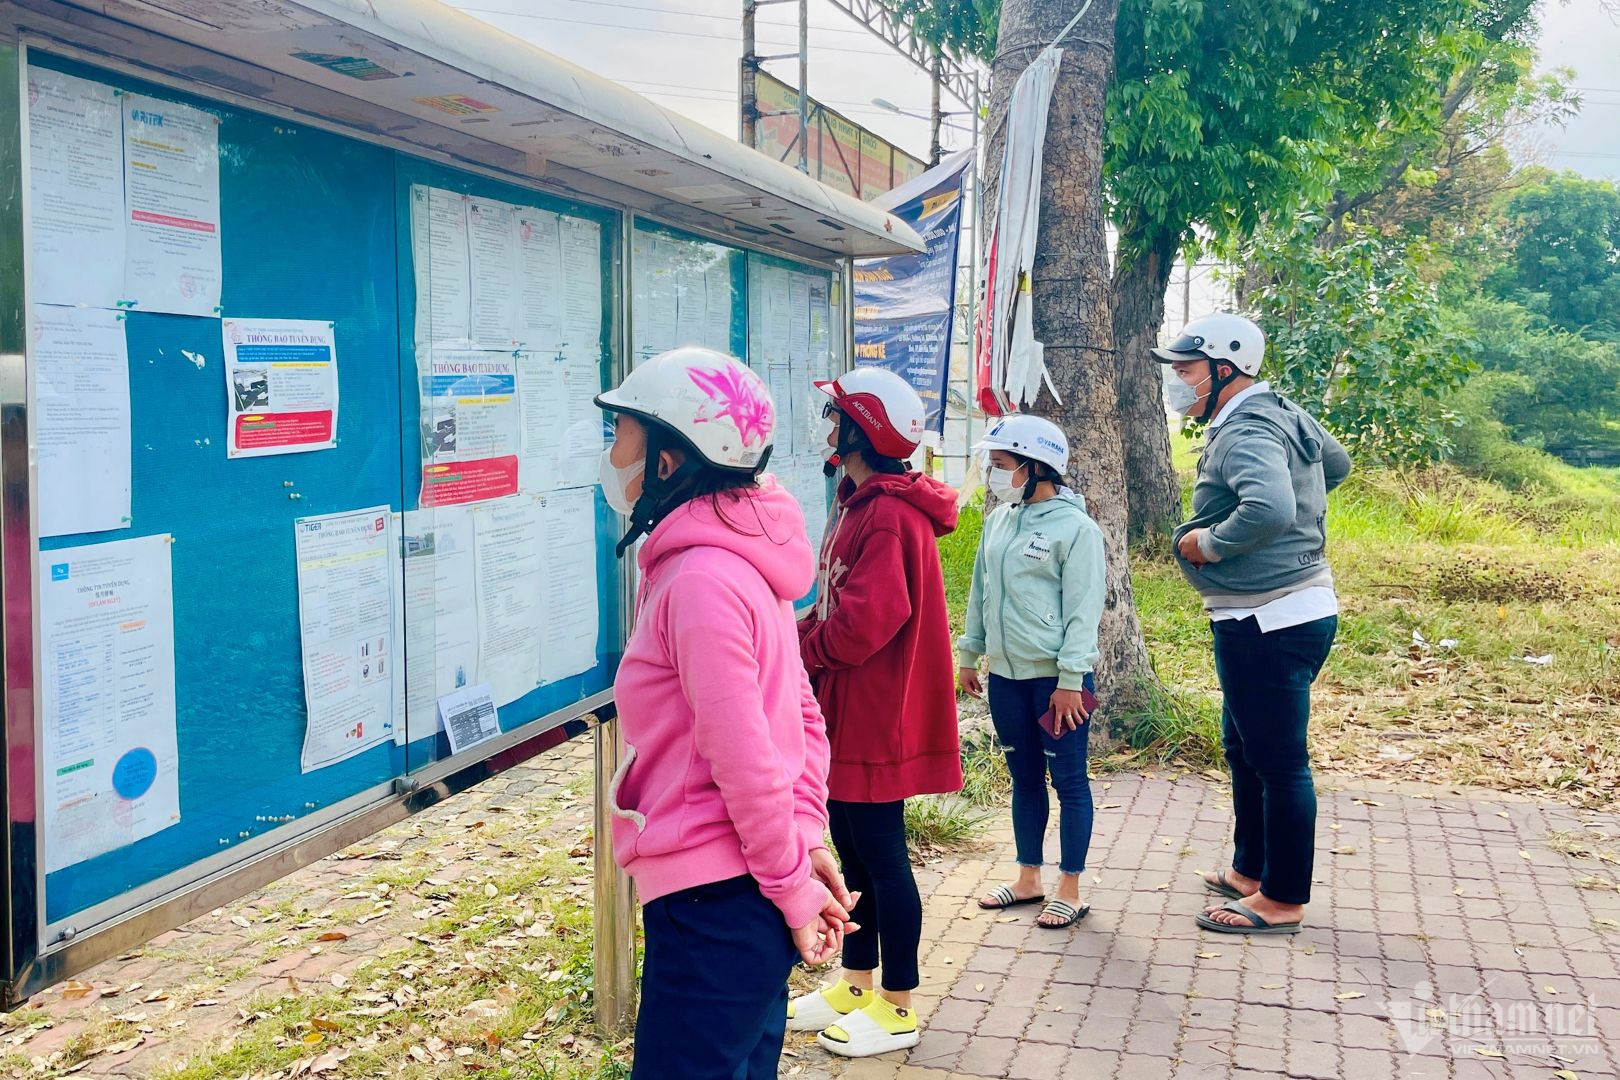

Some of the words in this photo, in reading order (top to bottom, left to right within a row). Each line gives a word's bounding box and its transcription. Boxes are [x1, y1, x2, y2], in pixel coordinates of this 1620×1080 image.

[433, 361, 461, 374] THÔNG
[462, 361, 478, 374] BÁO
[851, 400, 884, 431] AGRIBANK
[1044, 439, 1065, 455] YAMAHA
[305, 522, 322, 532] TIGER
